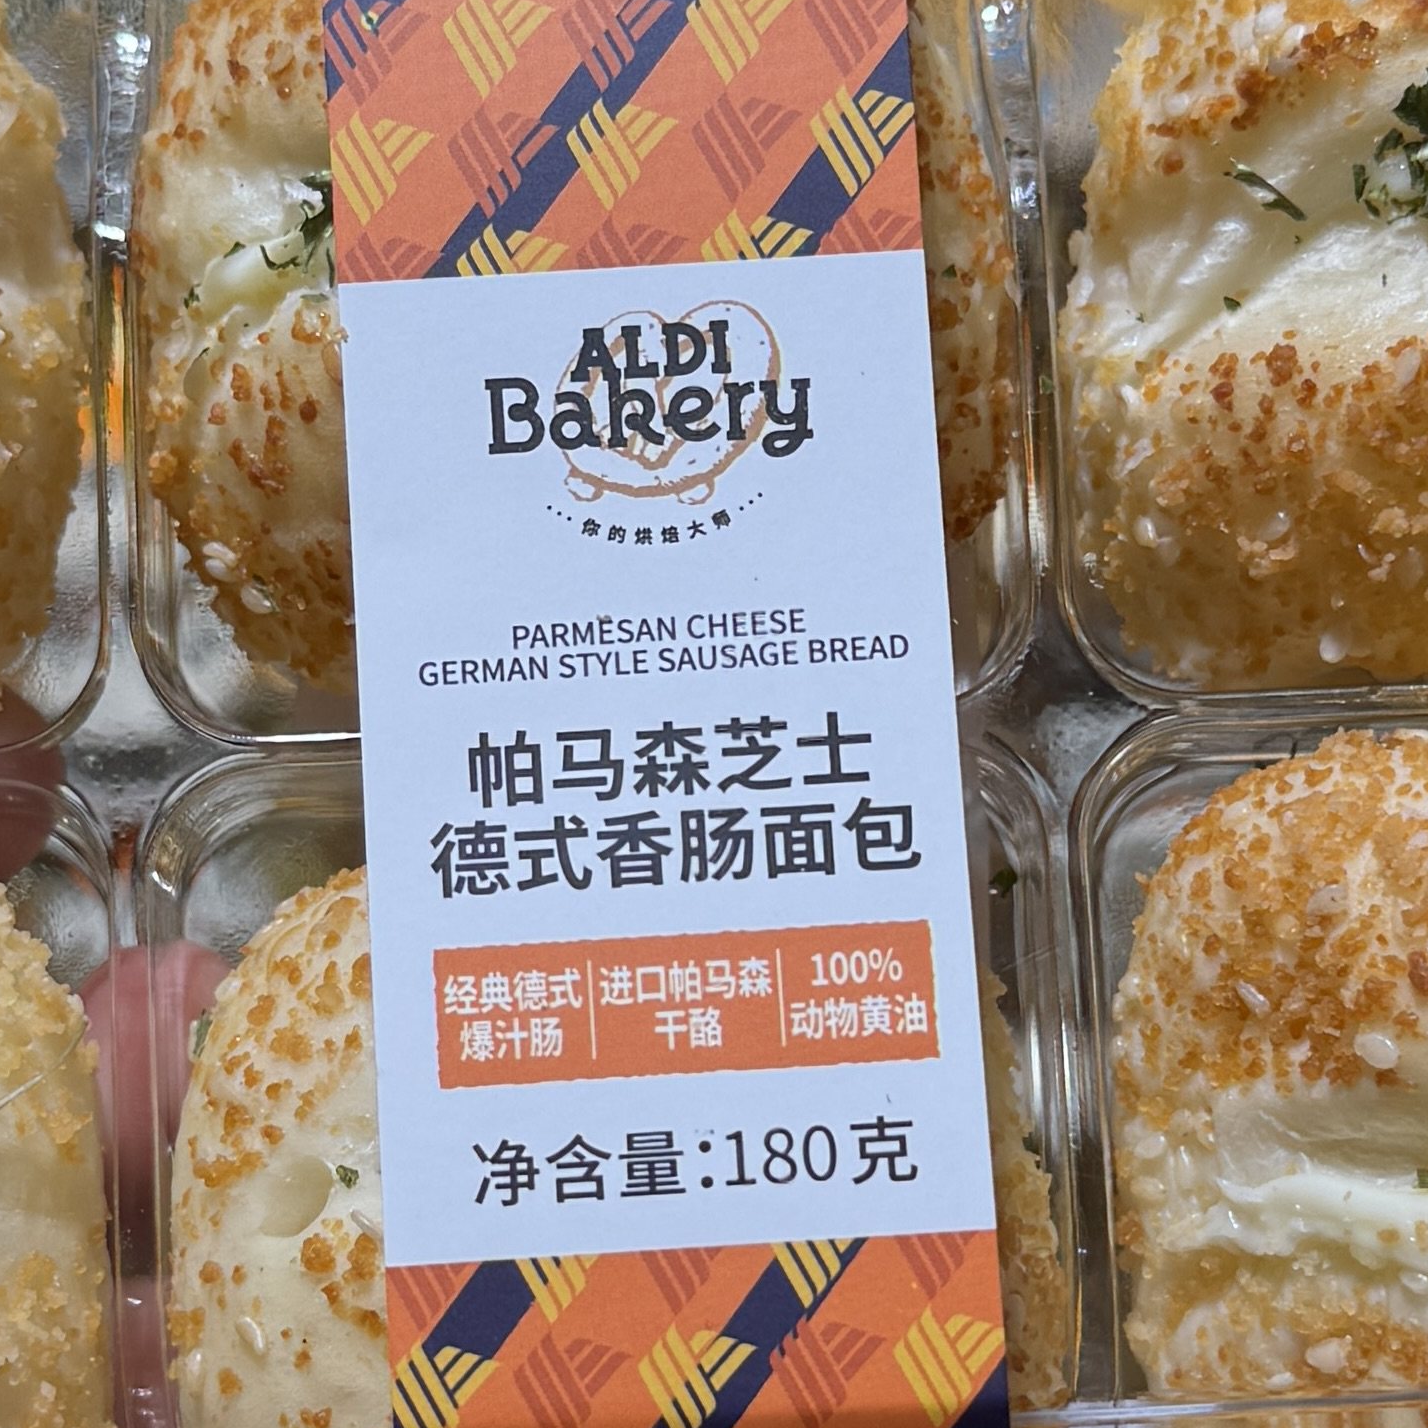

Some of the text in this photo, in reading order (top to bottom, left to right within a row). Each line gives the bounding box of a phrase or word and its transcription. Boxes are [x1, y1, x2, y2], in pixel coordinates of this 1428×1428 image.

[570, 319, 732, 383] ALDI
[484, 356, 814, 458] Bakery
[581, 508, 732, 545] 你的烘焙大师
[512, 608, 806, 650] PARMESAN CHEESE
[418, 634, 910, 687] GERMAN STYLE SAUSAGE BREAD
[468, 711, 873, 809] 帕马森芝士
[430, 796, 922, 899] 德式香肠面包
[443, 967, 583, 1016] 经典德式
[599, 956, 773, 1006] 进口帕马森
[810, 947, 903, 987] 100%
[459, 1016, 564, 1062] 爆汁肠
[654, 1005, 724, 1050] 干酪
[790, 992, 929, 1040] 动物黄油
